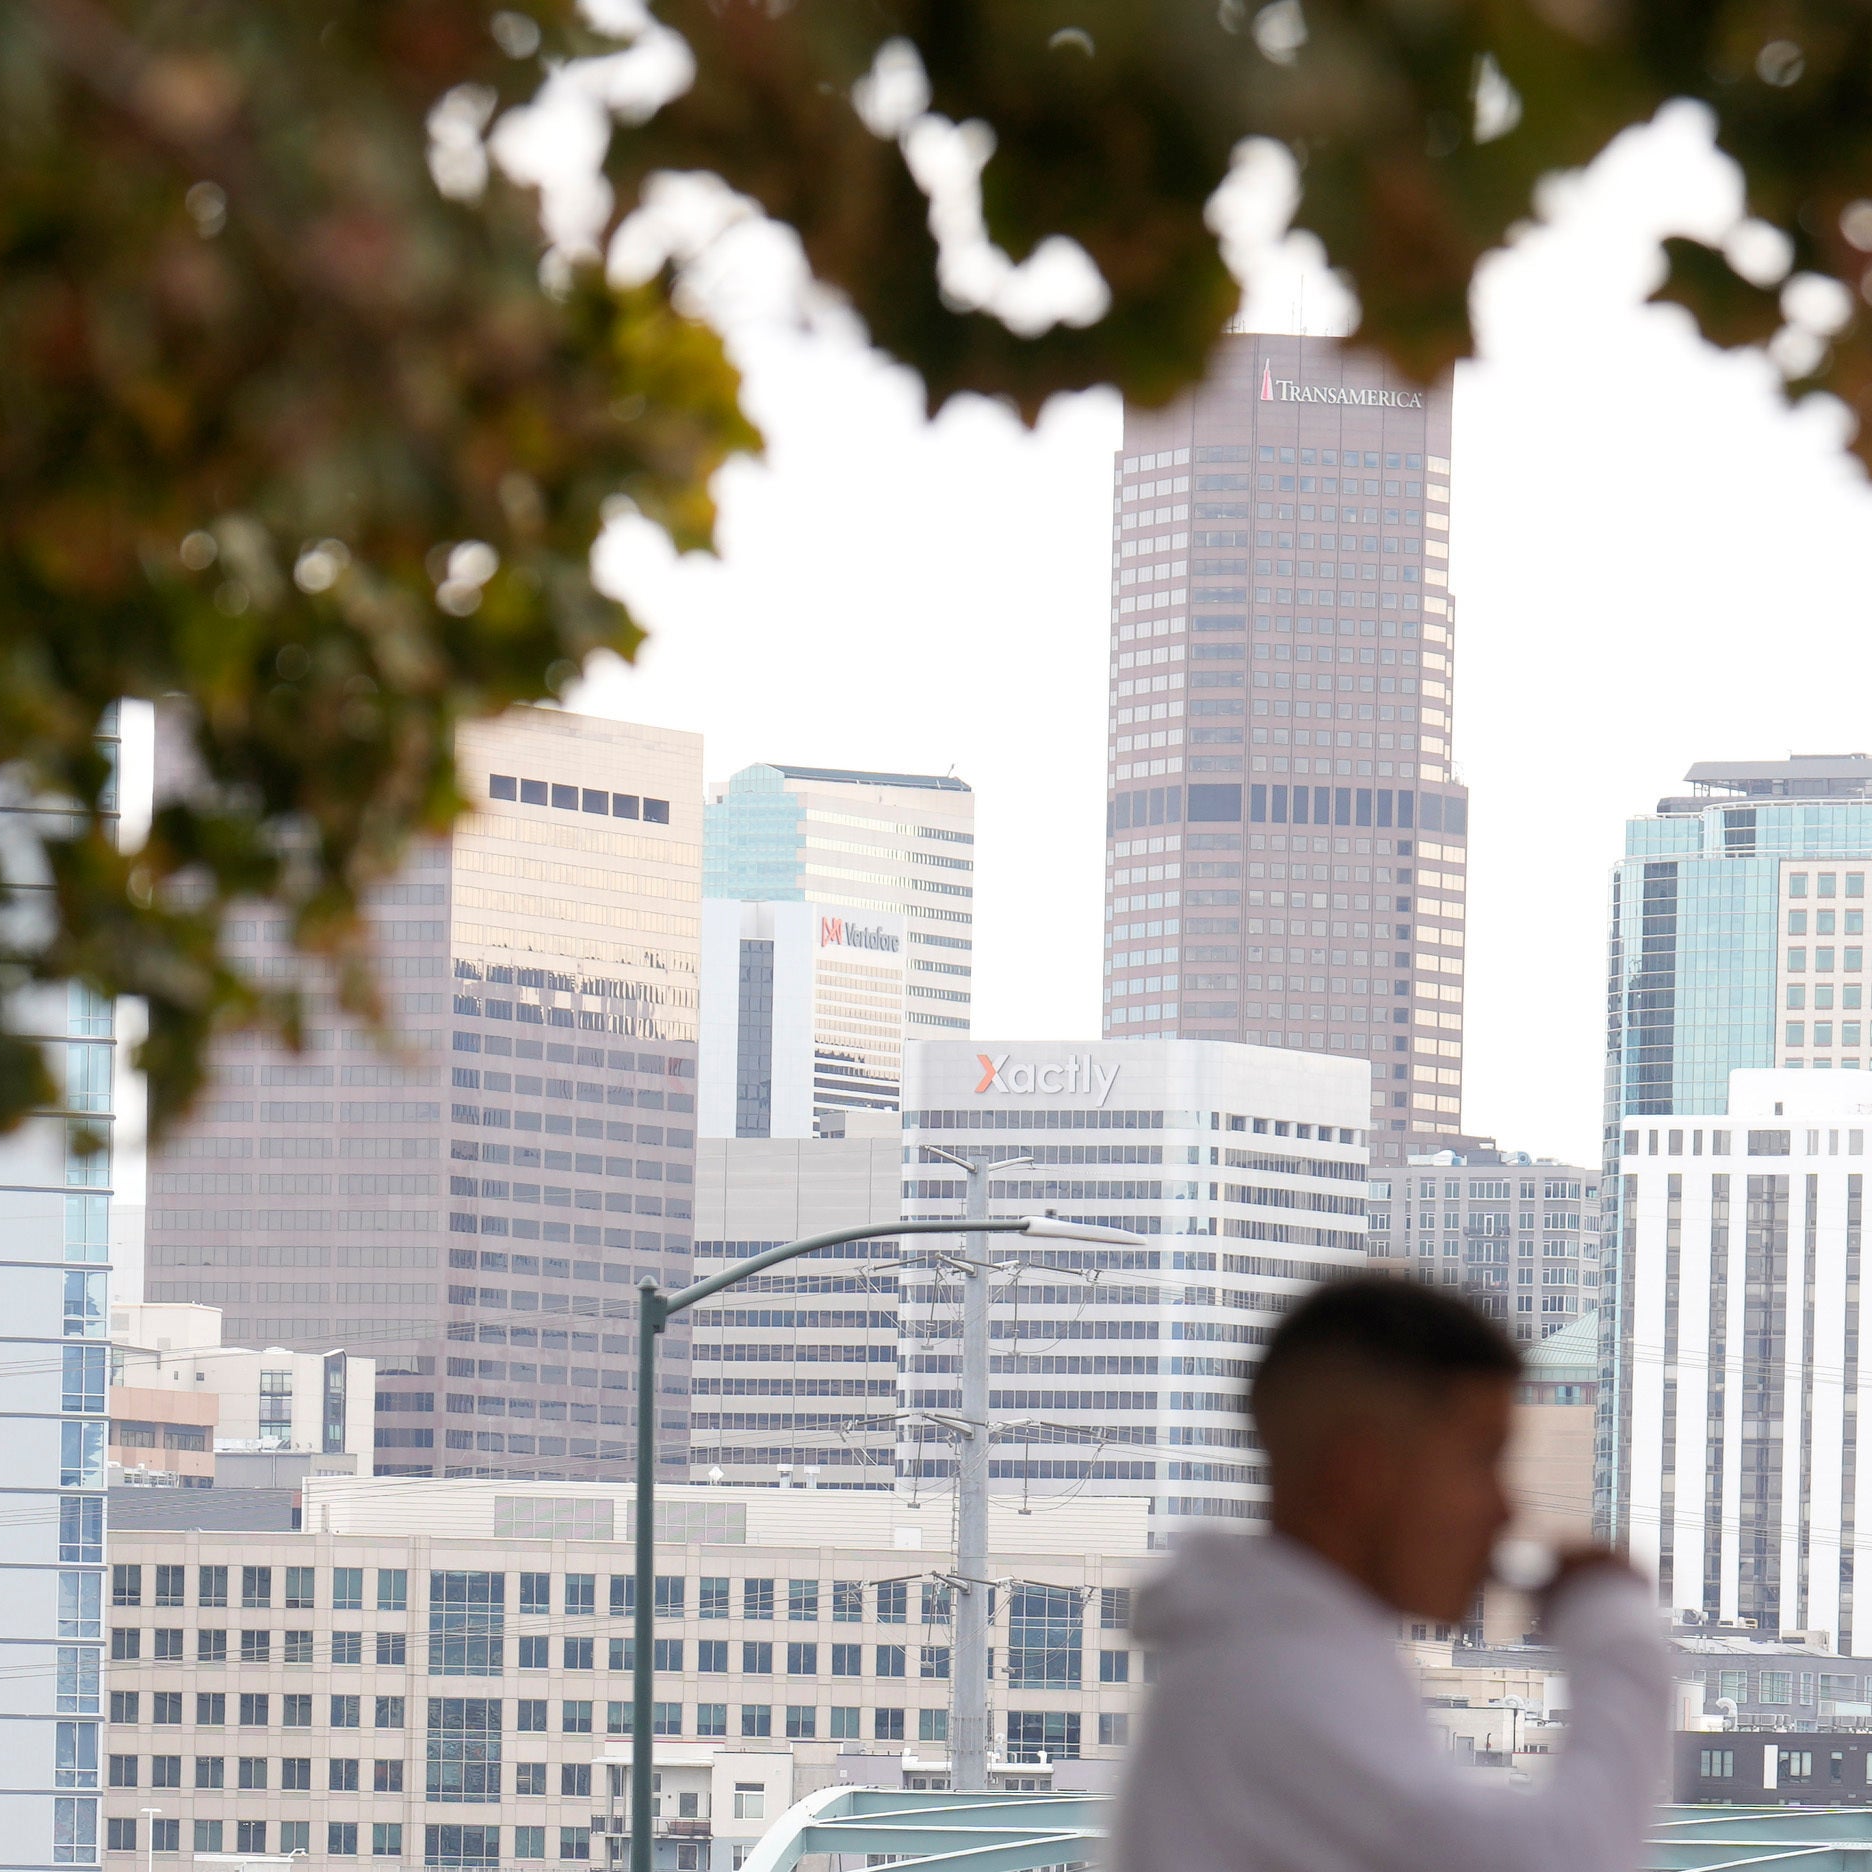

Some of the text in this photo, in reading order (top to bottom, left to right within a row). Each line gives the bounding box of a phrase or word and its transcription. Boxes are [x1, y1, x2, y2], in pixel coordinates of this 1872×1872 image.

[1276, 380, 1422, 408] TRANSAMERICA
[845, 922, 900, 952] Vertafore
[975, 1054, 1121, 1108] Xactly
